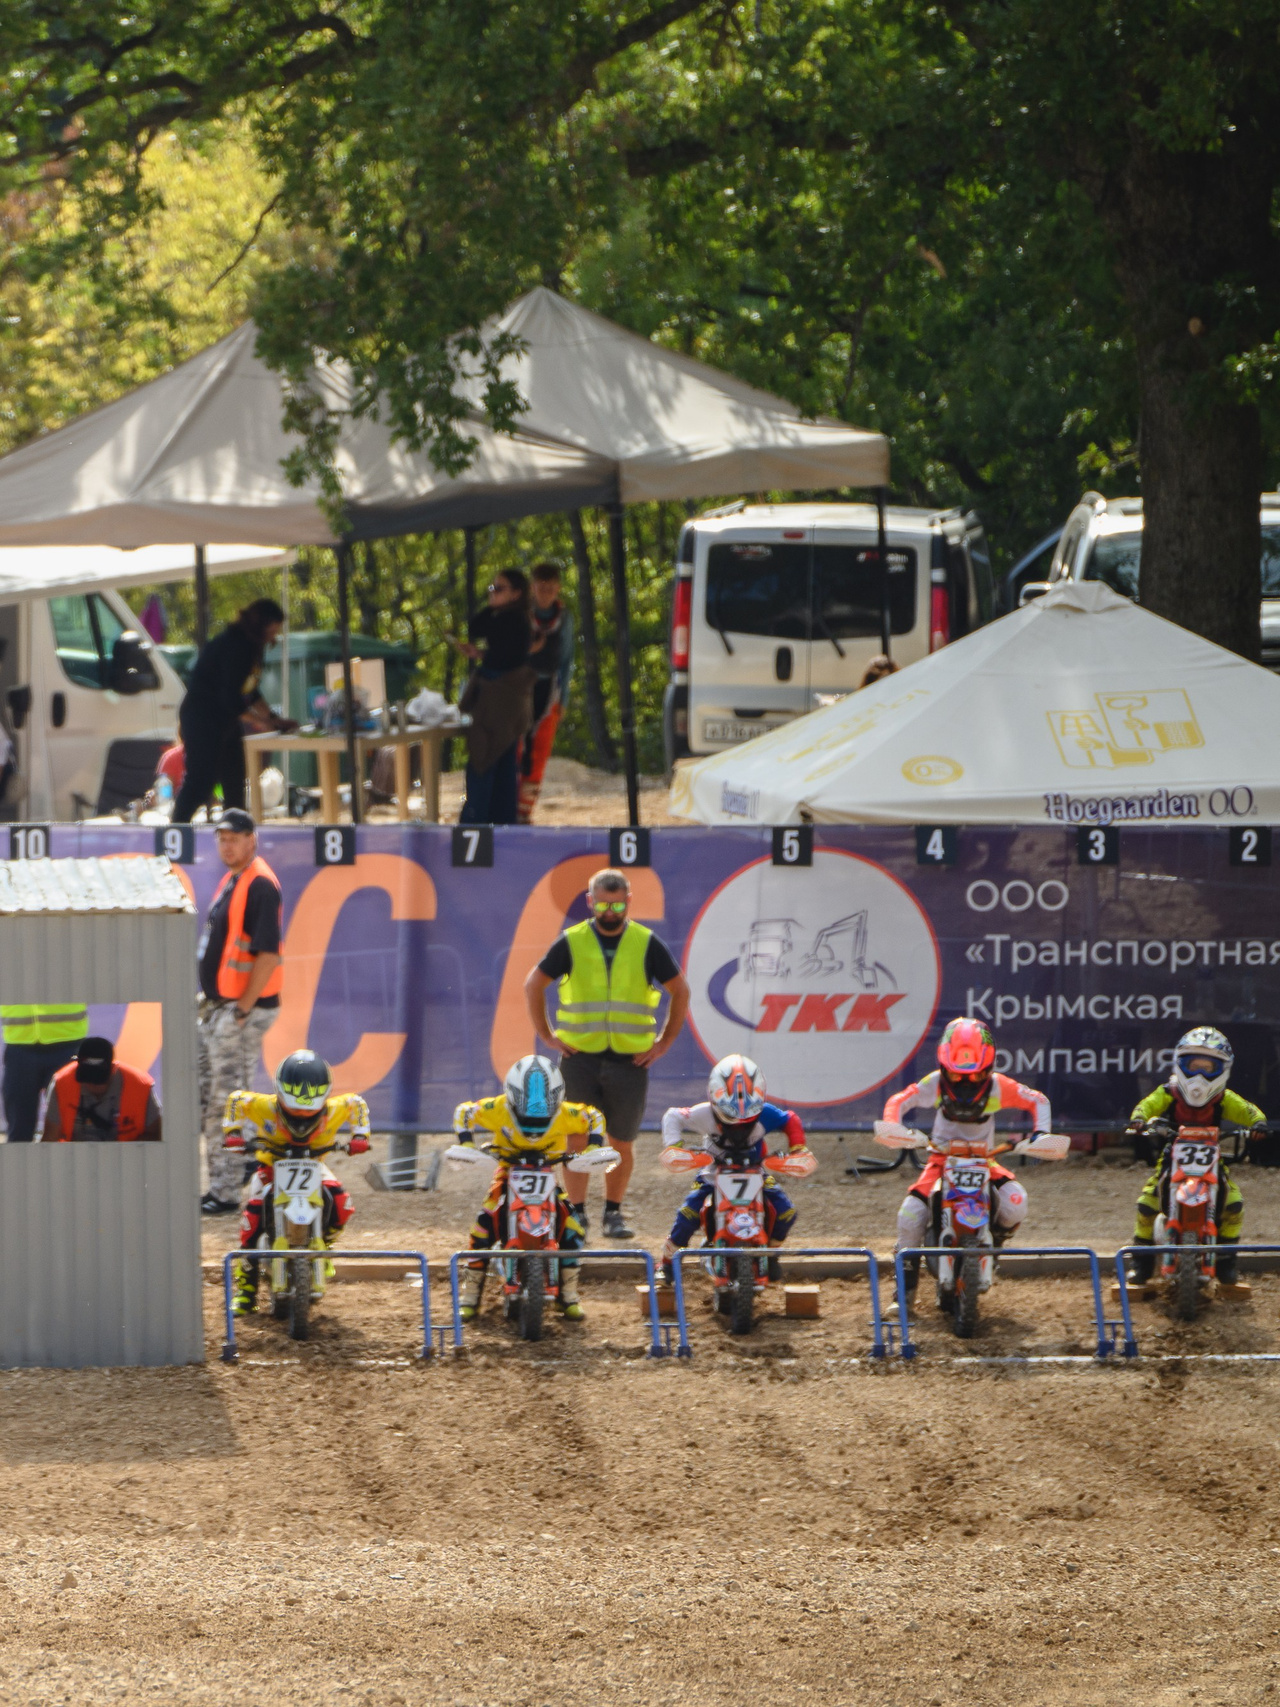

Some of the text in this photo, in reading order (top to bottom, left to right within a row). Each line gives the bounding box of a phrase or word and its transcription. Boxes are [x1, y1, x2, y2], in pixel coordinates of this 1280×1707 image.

[1044, 788, 1200, 825] Hoegaarden
[15, 828, 45, 859] 10
[163, 829, 183, 860] 9
[324, 829, 343, 863] 8
[462, 829, 480, 863] 7
[619, 831, 637, 864] 6
[782, 830, 800, 862] 5
[925, 830, 945, 860] 4
[1088, 829, 1106, 861] 3
[1241, 829, 1258, 862] 2
[966, 879, 1070, 911] ООО
[755, 993, 908, 1033] ТКК
[966, 987, 1183, 1028] Крымская
[992, 1048, 1176, 1074] омпания
[1177, 1146, 1216, 1165] 33
[285, 1168, 314, 1191] 72
[519, 1175, 549, 1195] 31
[731, 1178, 750, 1200] 7
[951, 1170, 985, 1188] 333
